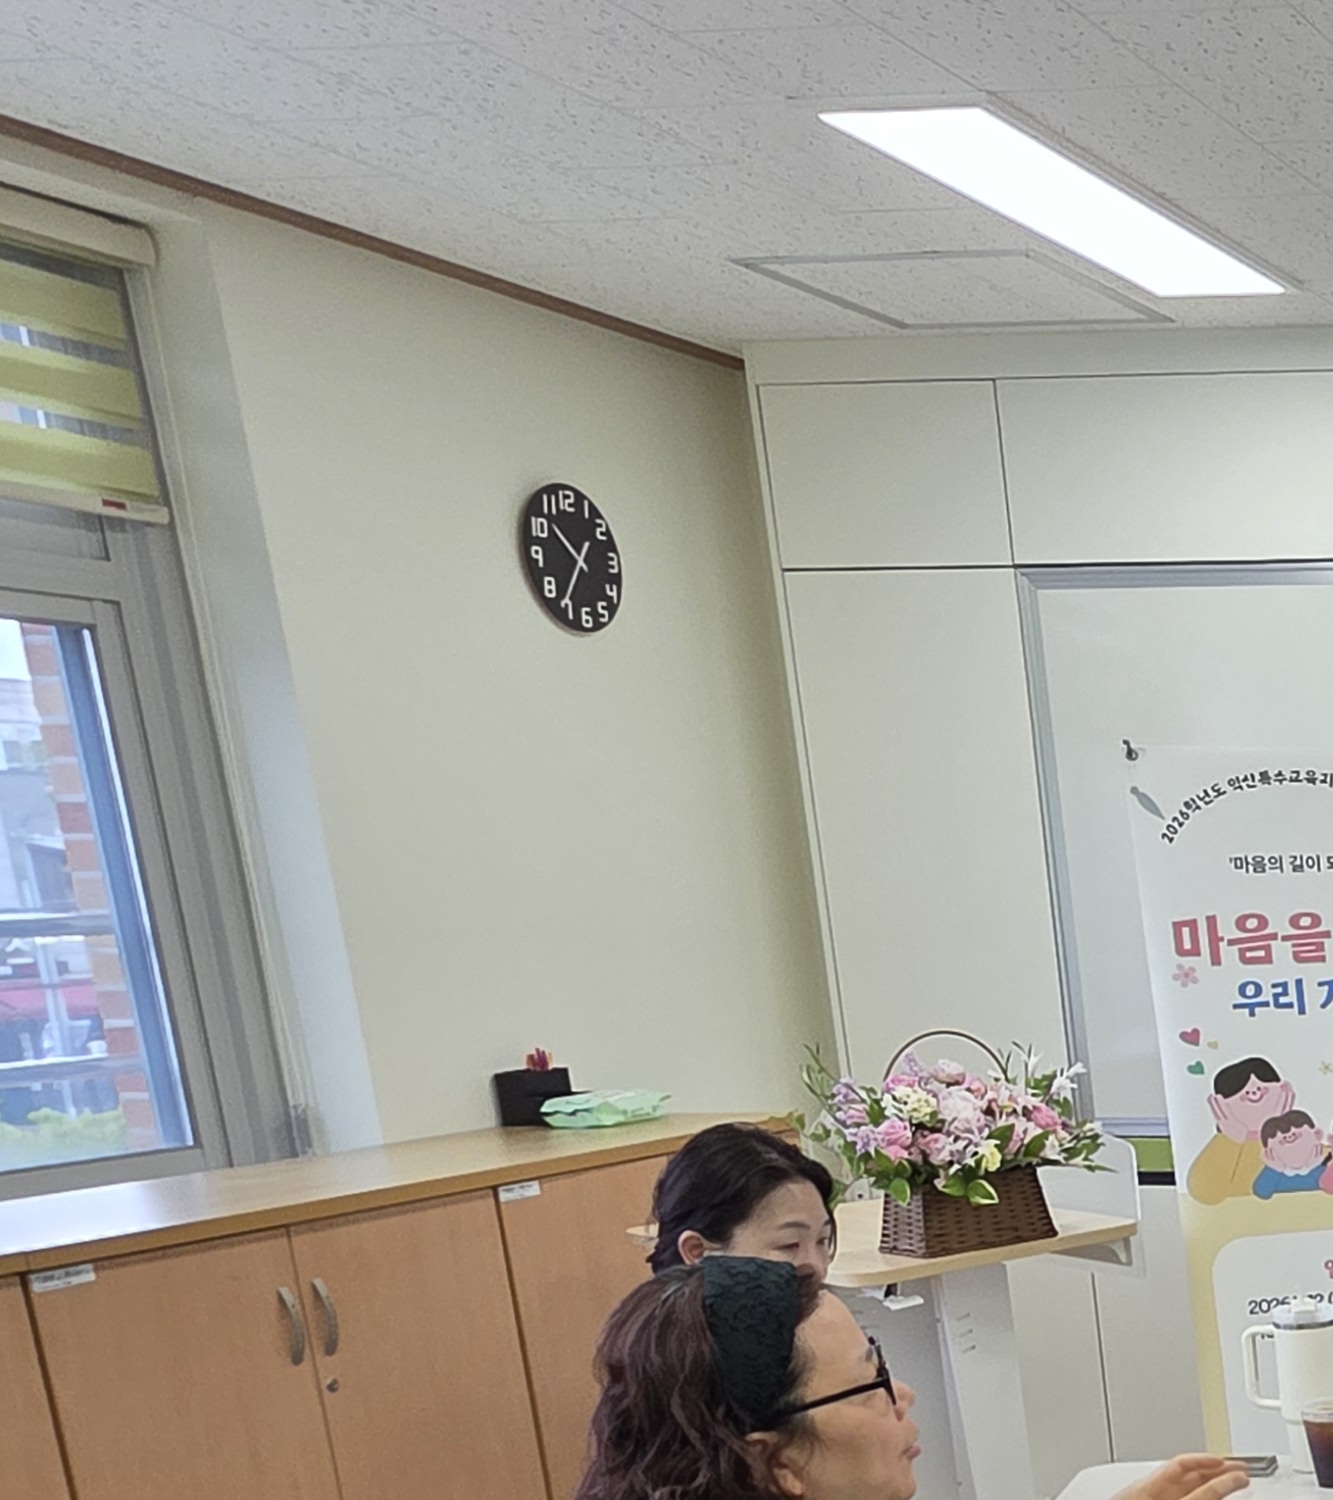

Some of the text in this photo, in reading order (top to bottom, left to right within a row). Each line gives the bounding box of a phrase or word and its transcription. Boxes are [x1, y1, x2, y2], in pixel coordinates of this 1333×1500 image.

[542, 493, 557, 515] 11
[558, 490, 576, 512] 12
[583, 499, 589, 519] 1
[531, 516, 549, 538] 10
[595, 519, 608, 541] 2
[530, 545, 544, 568] 9
[607, 552, 619, 574] 3
[544, 576, 557, 598] 8
[605, 584, 618, 605] 4
[560, 598, 574, 620] 7
[581, 607, 594, 628] 6
[597, 601, 609, 623] 5
[1161, 782, 1227, 844] 2026학년도
[1288, 854, 1322, 874] 길이
[1171, 911, 1333, 967] 마음을
[1231, 978, 1308, 1018] 우리
